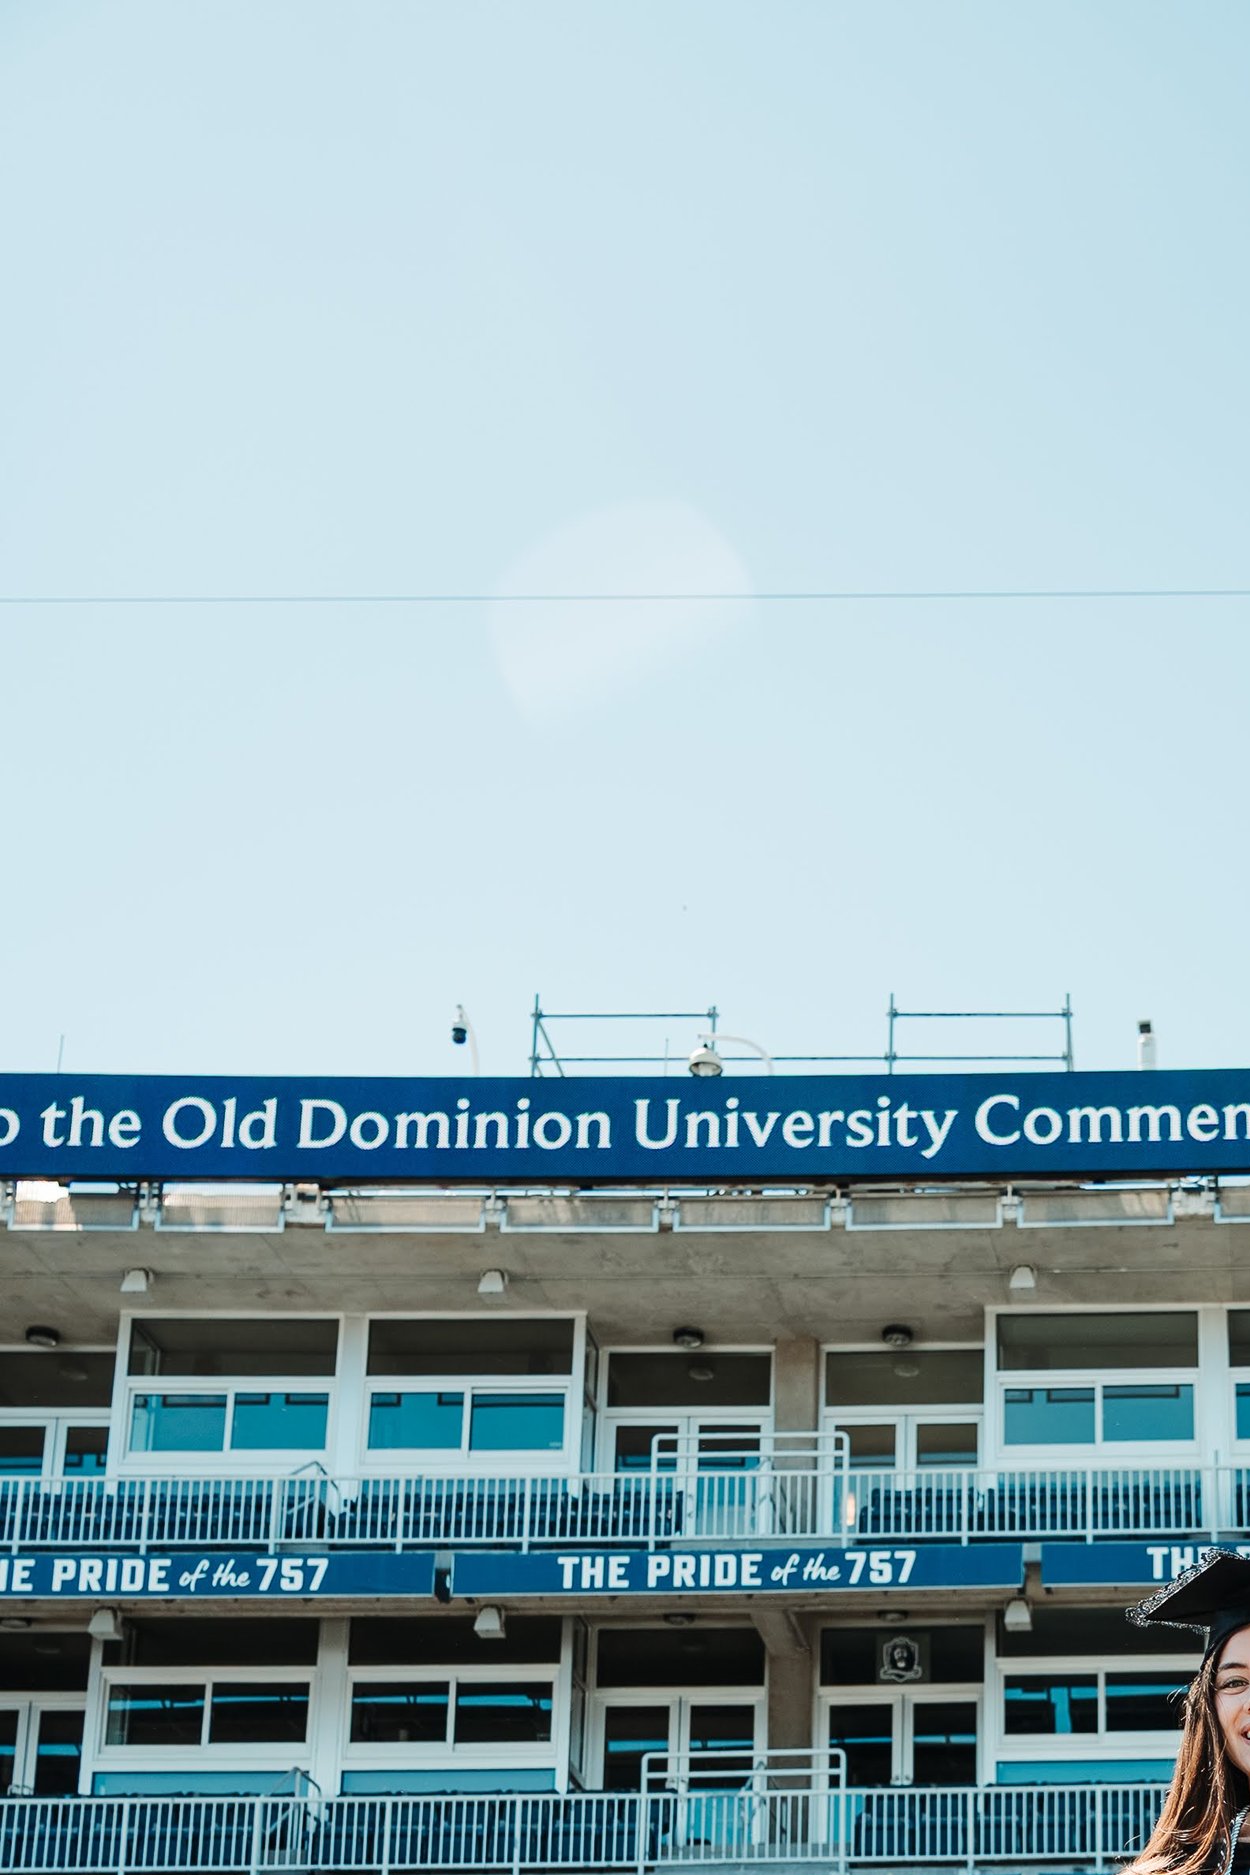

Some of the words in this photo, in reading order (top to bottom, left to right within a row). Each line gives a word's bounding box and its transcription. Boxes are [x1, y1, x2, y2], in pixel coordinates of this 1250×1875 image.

[0, 1109, 20, 1146] o
[41, 1096, 142, 1148] the
[162, 1096, 277, 1149] Old
[297, 1098, 611, 1150] Dominion
[634, 1096, 958, 1159] University
[51, 1558, 172, 1592] PRIDE
[179, 1559, 209, 1592] of
[212, 1559, 250, 1588] the
[255, 1558, 329, 1591] 757
[557, 1555, 630, 1589] THE
[647, 1553, 763, 1588] PRIDE
[770, 1553, 800, 1586] of
[802, 1553, 841, 1581] the
[845, 1550, 917, 1584] 757
